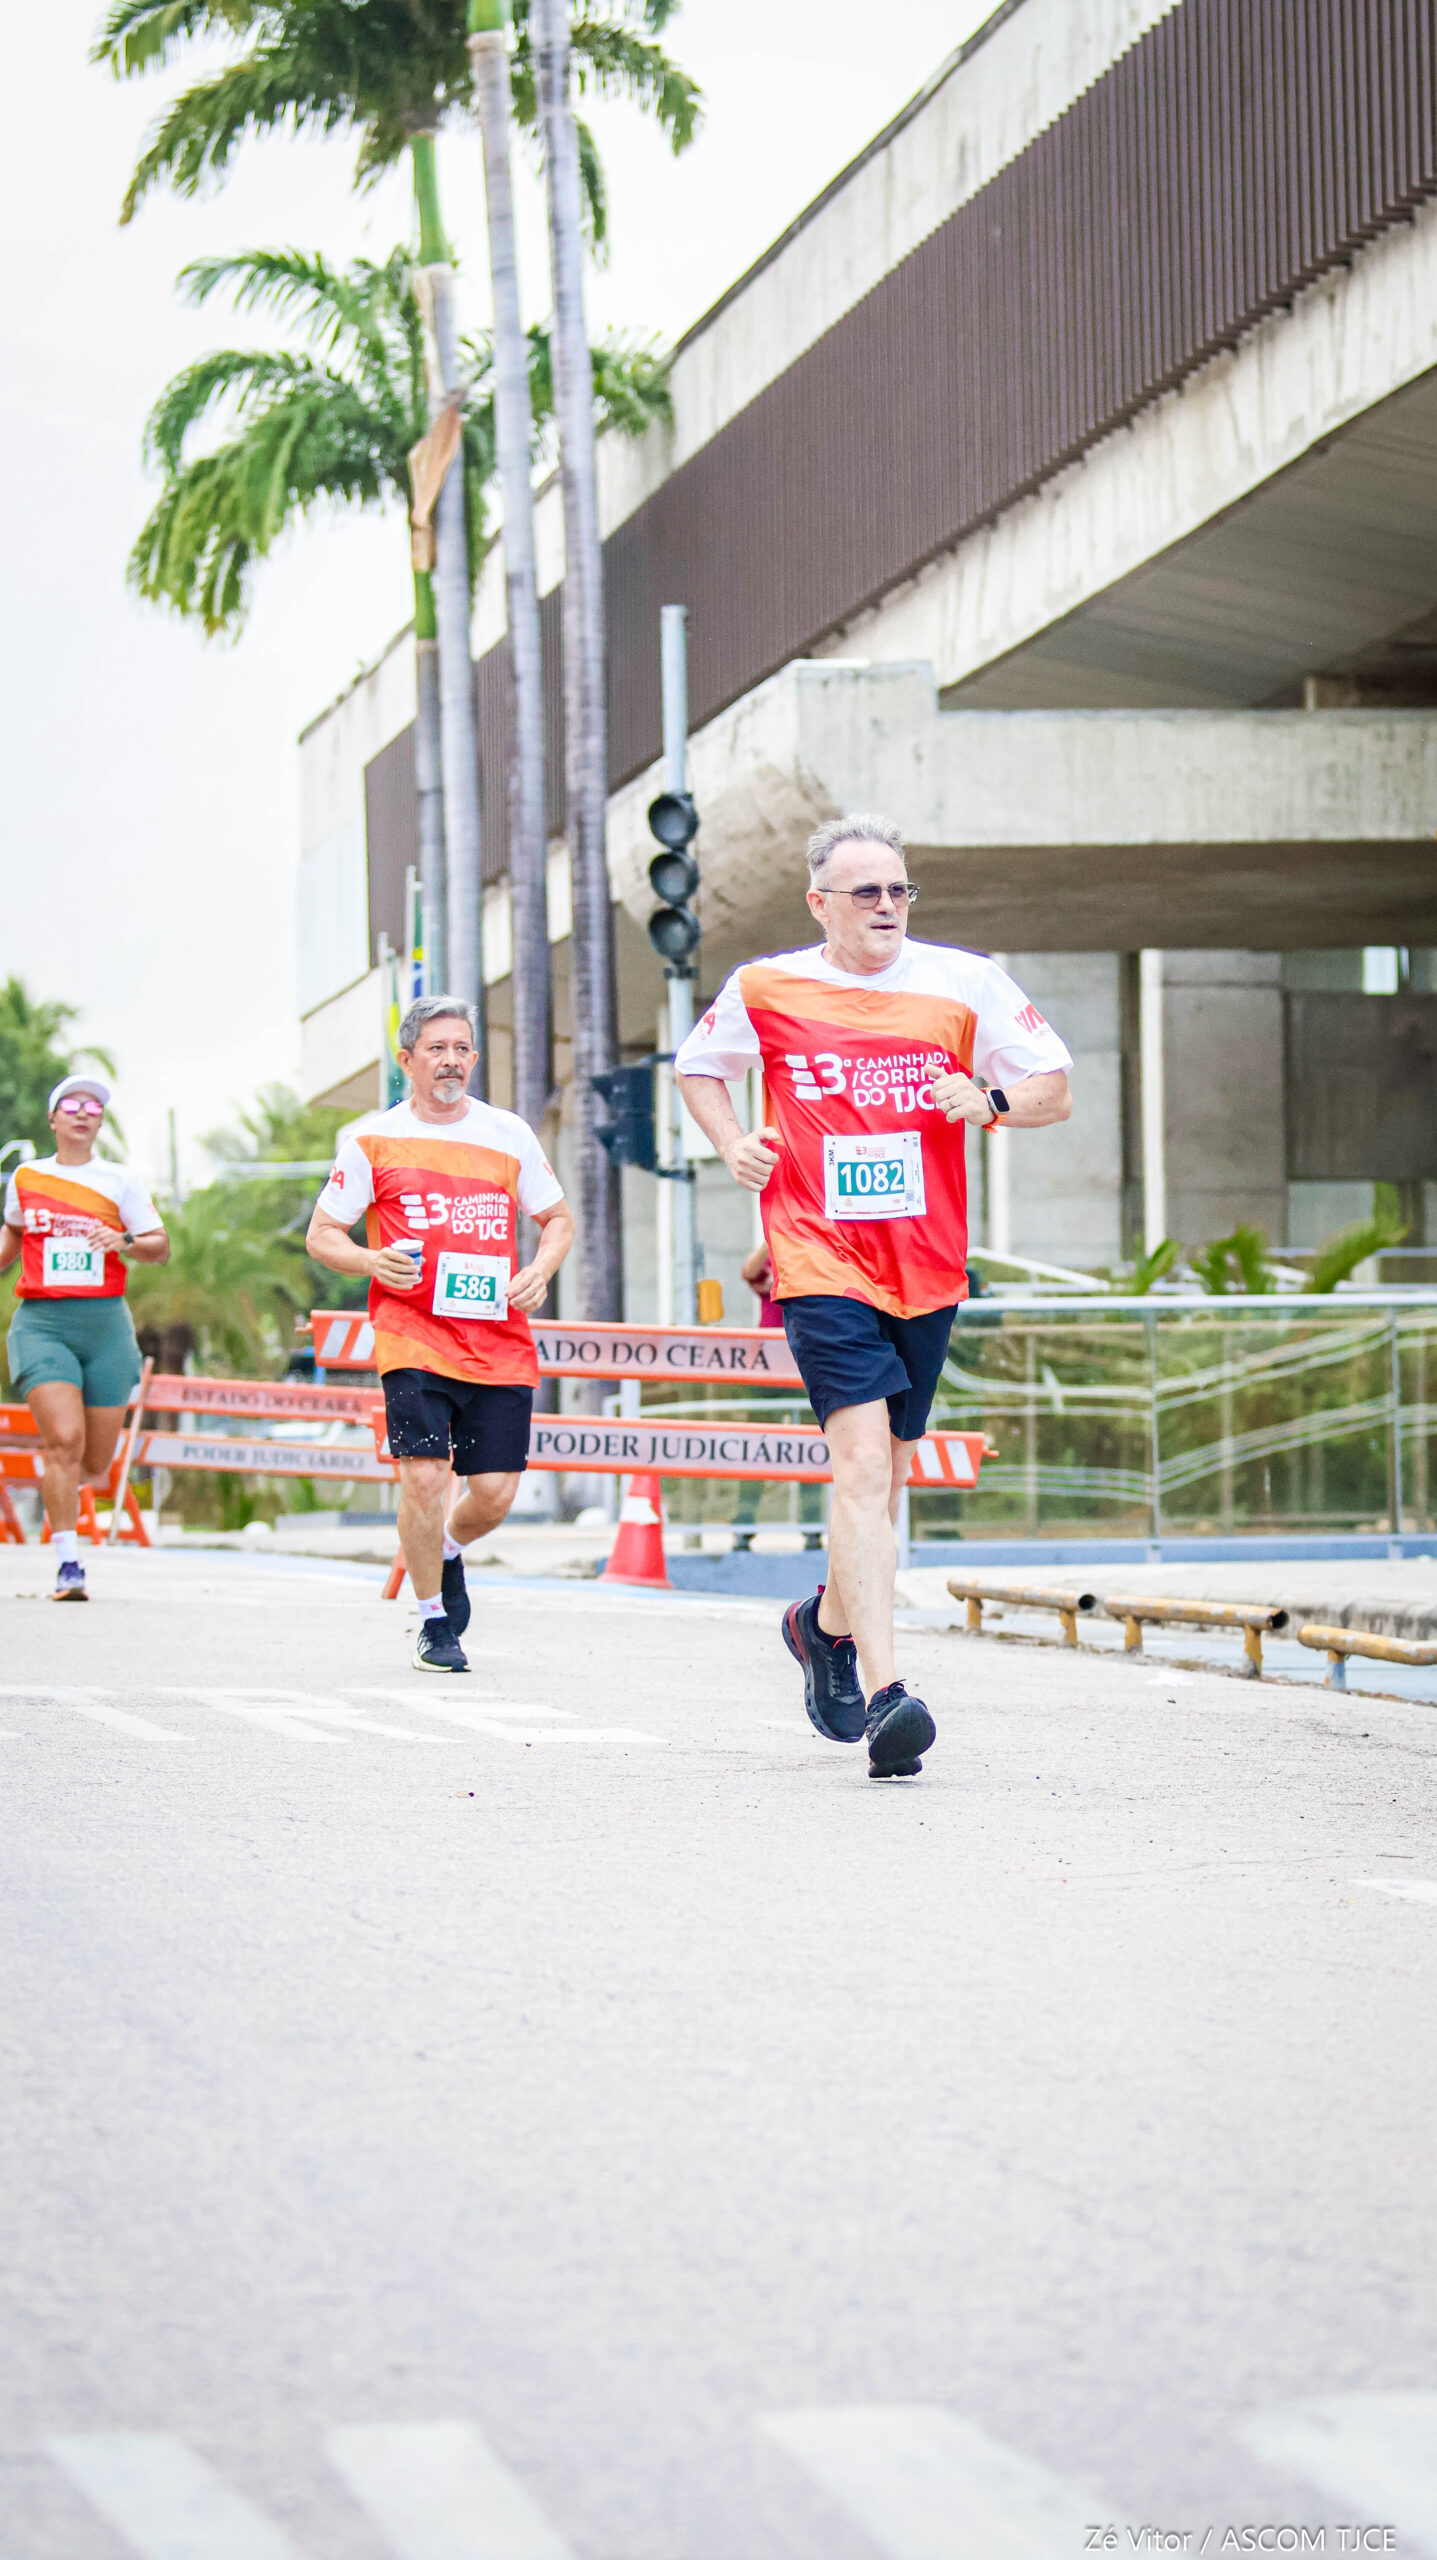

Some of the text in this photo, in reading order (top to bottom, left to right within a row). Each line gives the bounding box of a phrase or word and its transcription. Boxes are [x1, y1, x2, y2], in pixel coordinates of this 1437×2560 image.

[856, 1051, 951, 1071] CAMINHADA
[852, 1065, 947, 1088] /CORRI
[853, 1083, 940, 1113] DO TJC
[840, 1161, 905, 1194] 1082
[452, 1218, 508, 1241] DO TJCE
[56, 1252, 88, 1271] 980
[453, 1275, 491, 1300] 586
[537, 1339, 770, 1371] ADO DO CEARÁ
[535, 1430, 831, 1466] PODER JUDICIÁRIO
[0, 1685, 673, 1743] TRE
